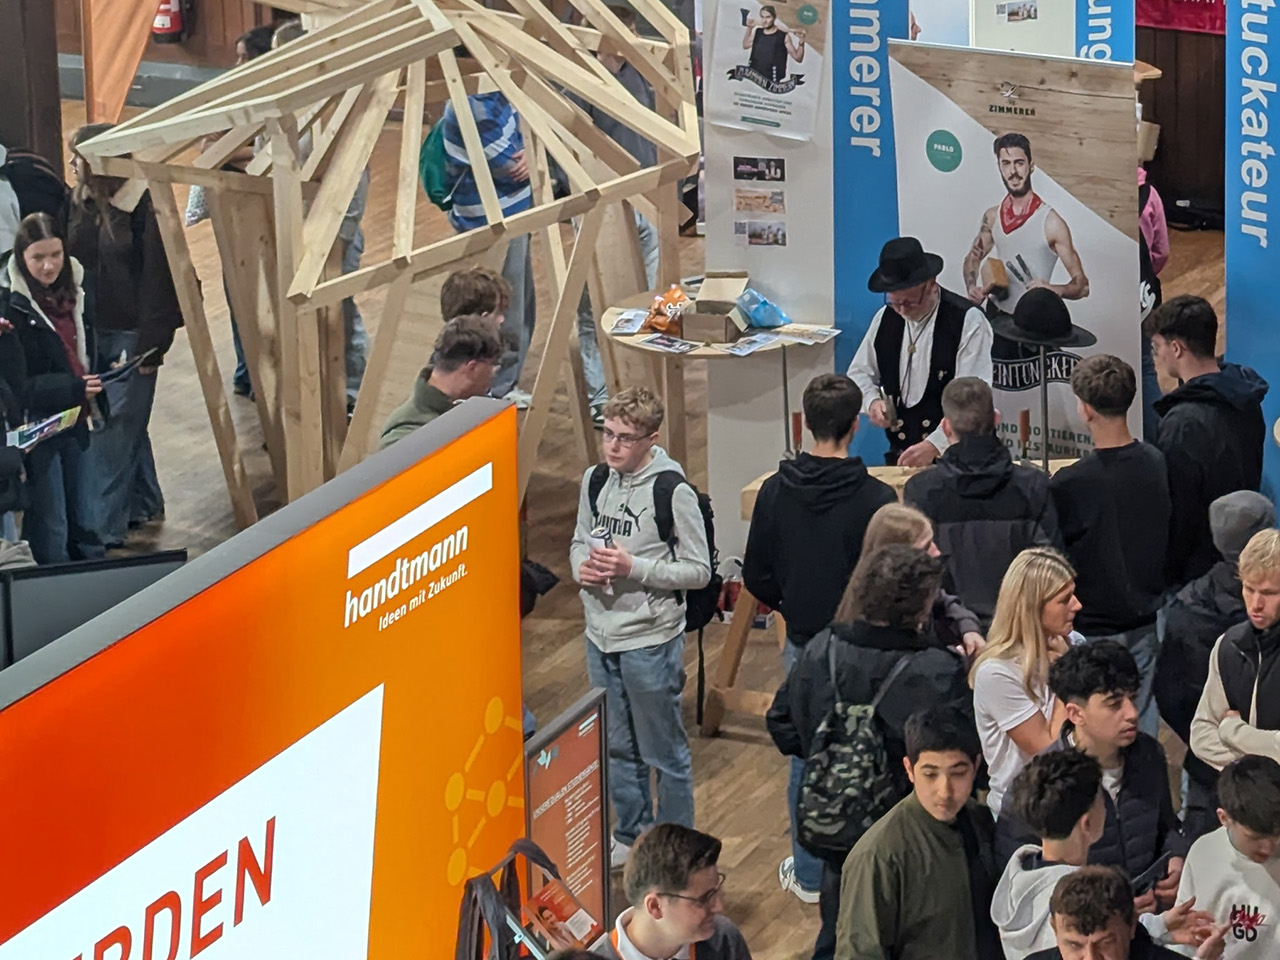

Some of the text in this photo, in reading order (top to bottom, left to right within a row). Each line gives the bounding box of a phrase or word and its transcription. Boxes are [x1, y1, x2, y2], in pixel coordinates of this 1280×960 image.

[344, 525, 468, 628] handtmann
[378, 563, 468, 631] Ideen mit Zukunft.
